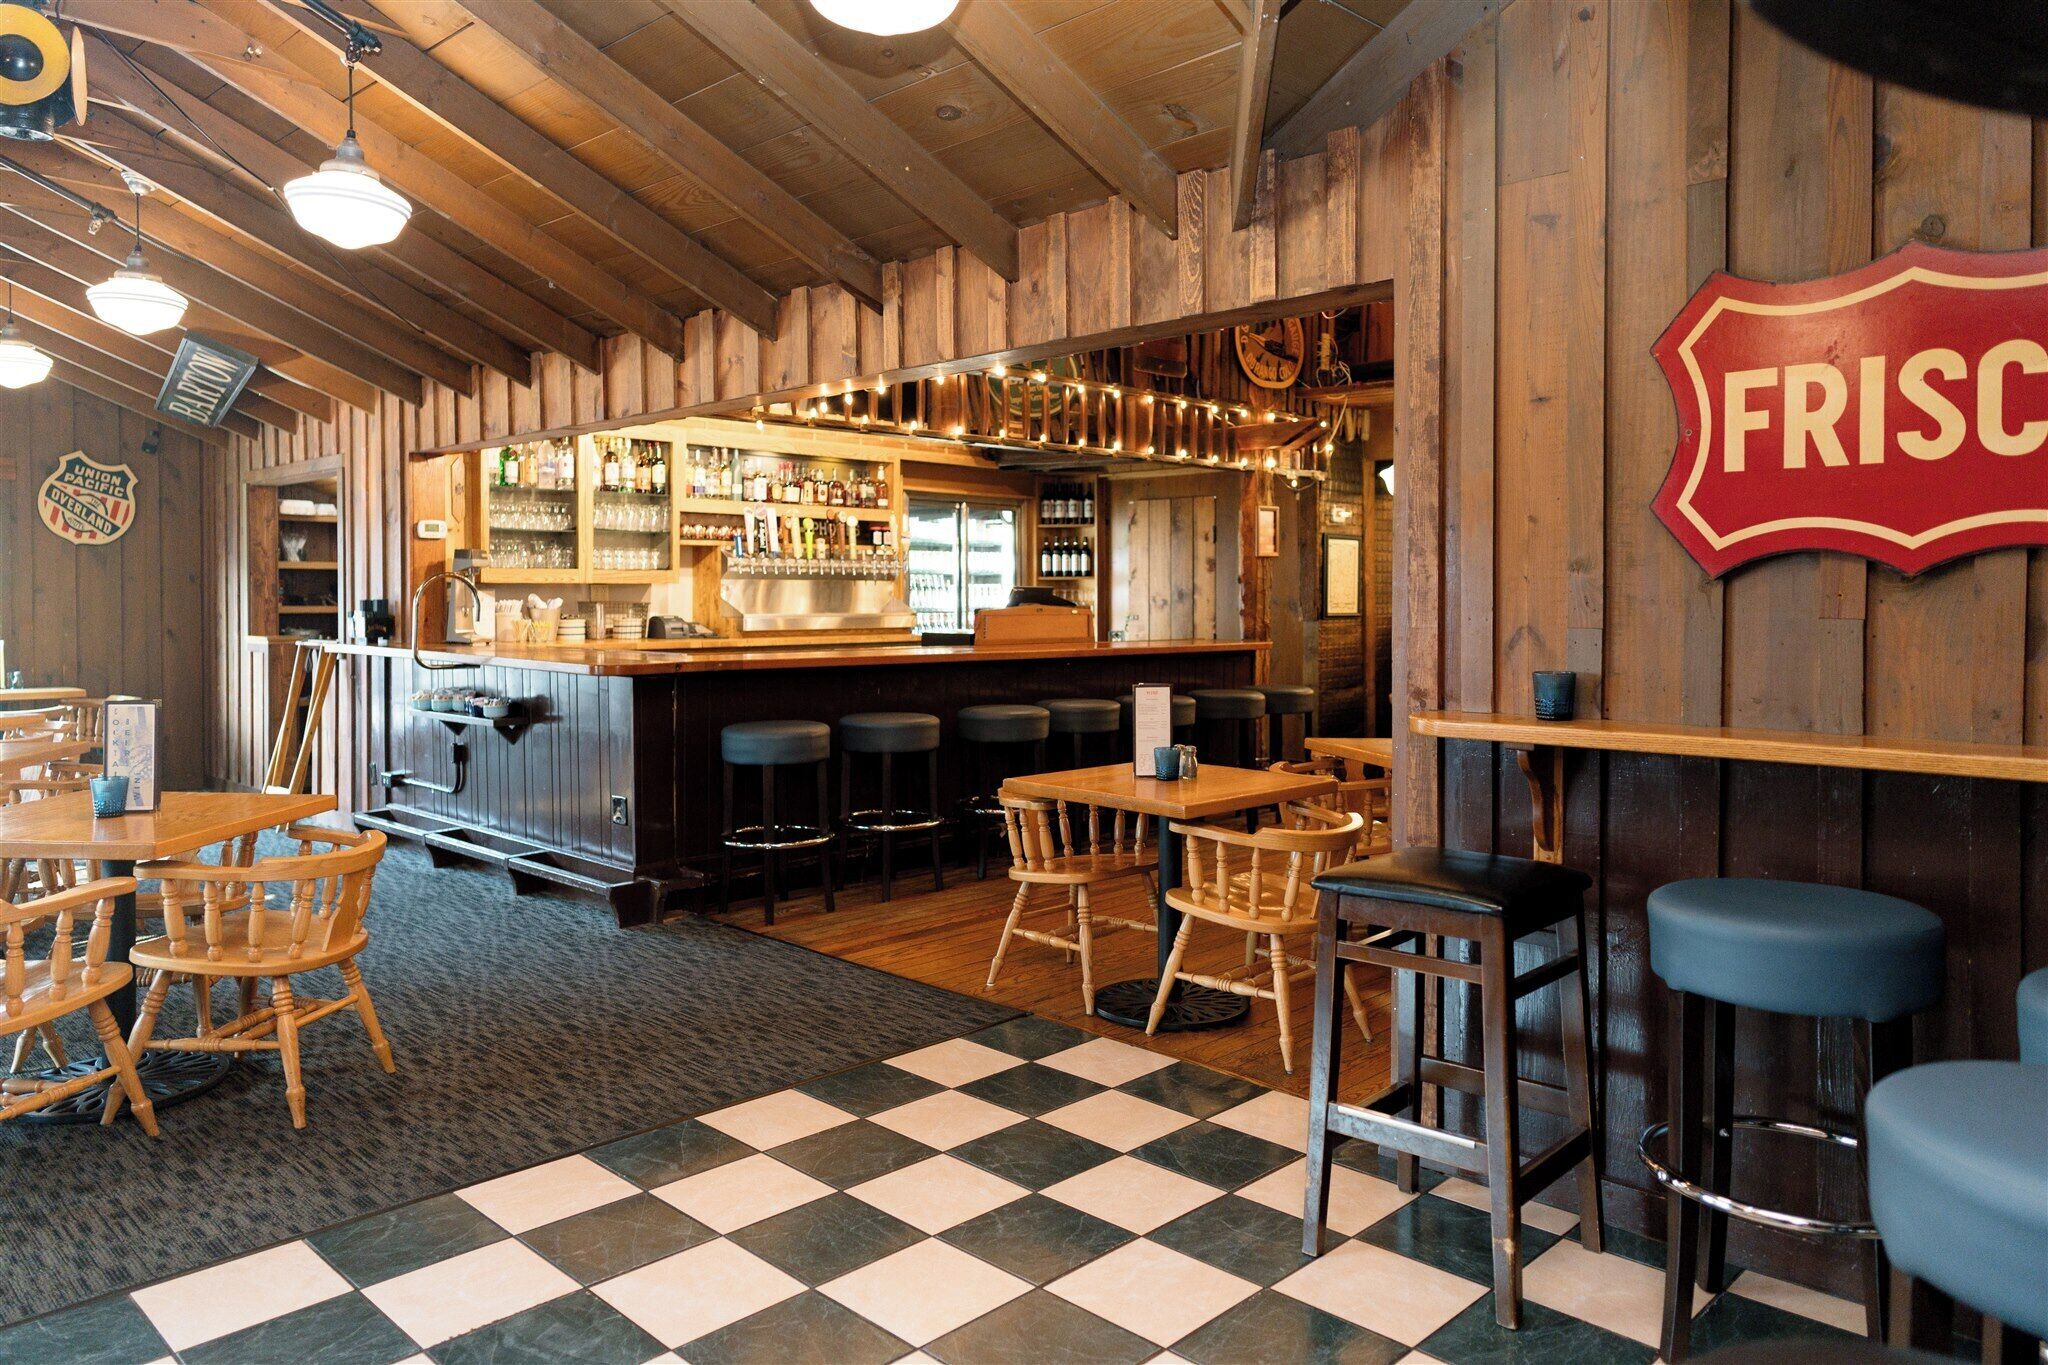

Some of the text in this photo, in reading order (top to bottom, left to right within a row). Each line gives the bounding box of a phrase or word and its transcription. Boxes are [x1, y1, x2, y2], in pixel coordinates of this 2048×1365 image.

[168, 346, 239, 425] BARTOW
[1723, 339, 2048, 473] FRISC
[63, 472, 125, 496] PACIFIC
[74, 465, 122, 486] UNION
[51, 488, 112, 534] OVERLAND
